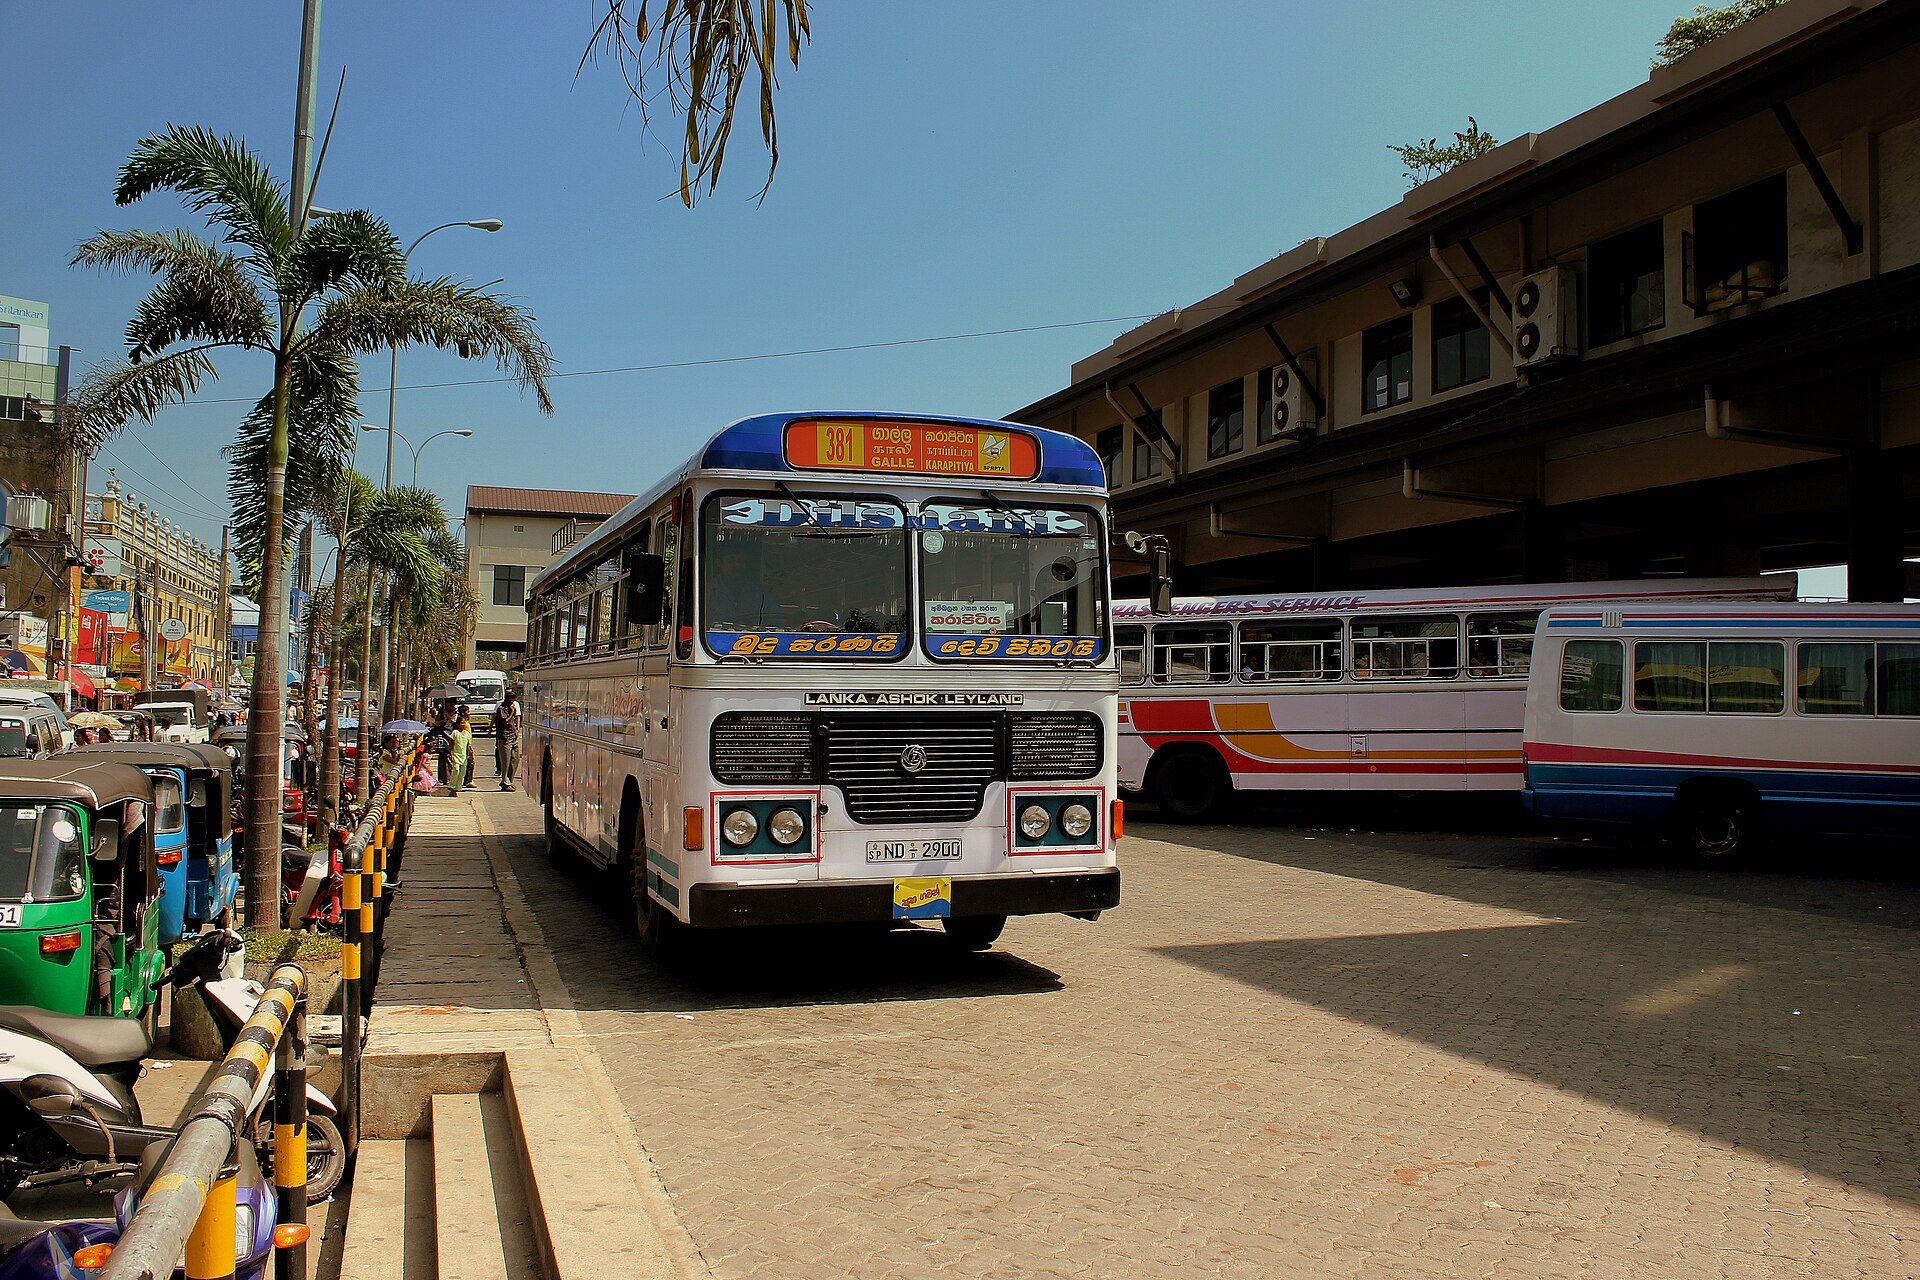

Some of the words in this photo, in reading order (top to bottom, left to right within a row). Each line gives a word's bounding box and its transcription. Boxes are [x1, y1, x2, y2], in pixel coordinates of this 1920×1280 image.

[872, 425, 912, 444] ගාල්ල
[826, 426, 853, 462] 381
[871, 456, 915, 468] GALLE
[925, 460, 975, 472] KARAPITIYA
[1112, 600, 1260, 617] PASENGERS
[1263, 596, 1366, 612] SERVICE
[728, 634, 779, 655] බුදු
[788, 635, 898, 653] සරණයි
[940, 637, 1001, 656] දෙවි
[1005, 638, 1096, 656] පිහිටයි
[805, 693, 869, 704] LANKA
[875, 693, 938, 704] ASHOK
[944, 693, 1024, 704] LEYLAND
[884, 843, 905, 859] ND
[922, 842, 960, 857] 2900
